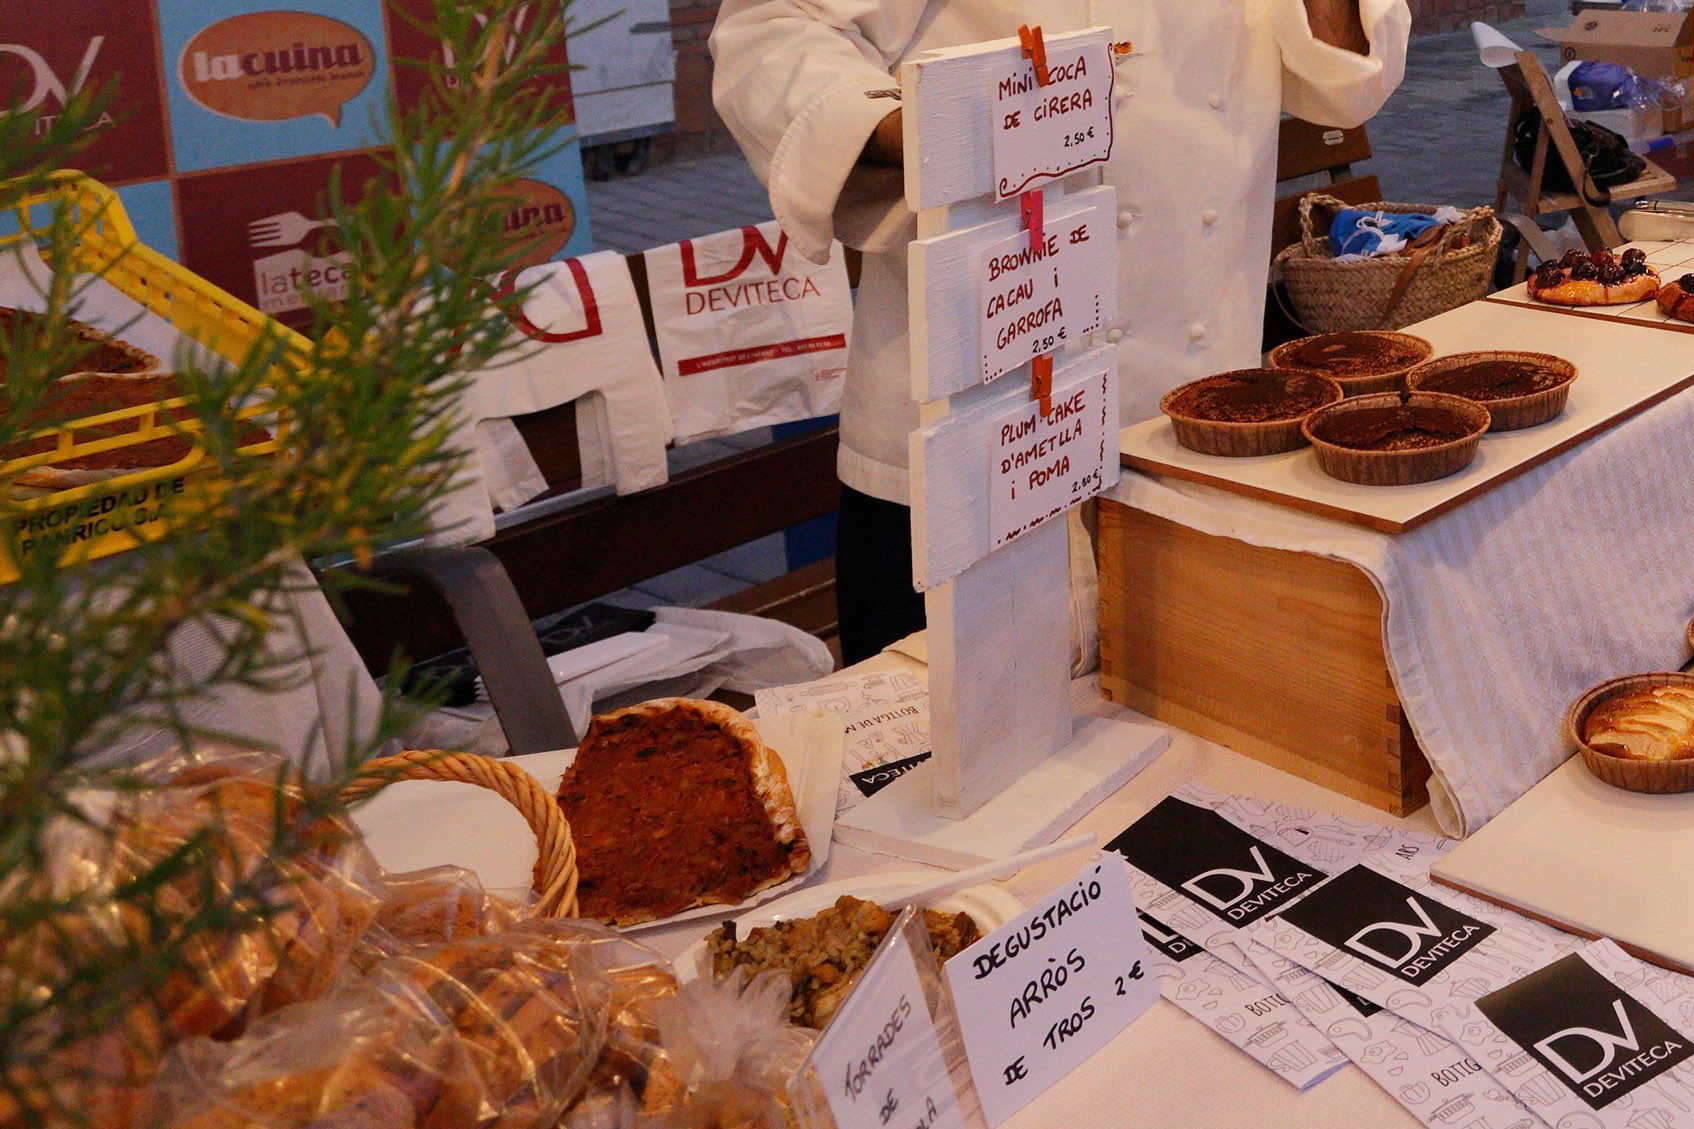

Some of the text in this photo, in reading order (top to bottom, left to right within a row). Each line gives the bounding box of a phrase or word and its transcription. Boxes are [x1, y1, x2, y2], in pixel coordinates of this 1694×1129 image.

[1047, 55, 1087, 86] COCA
[1003, 111, 1021, 131] DE
[1069, 224, 1090, 245] DE
[685, 275, 821, 316] DEVITECA
[996, 297, 1063, 351] GARROFA
[1001, 390, 1087, 447] PLUM CAKE
[1001, 418, 1083, 475] D'AMETLLA
[1029, 455, 1070, 491] POMA
[1181, 845, 1275, 911] DV
[1227, 871, 1312, 921] DEVITECA
[1344, 896, 1442, 969] DV
[1401, 923, 1480, 978] DEVITECA
[1009, 947, 1086, 1029] ARRÒS
[1003, 1055, 1028, 1086] DE
[1042, 995, 1095, 1050] TROS
[1115, 976, 1126, 996] 2
[1533, 998, 1640, 1085] DV
[1582, 1038, 1683, 1099] DEVITECA
